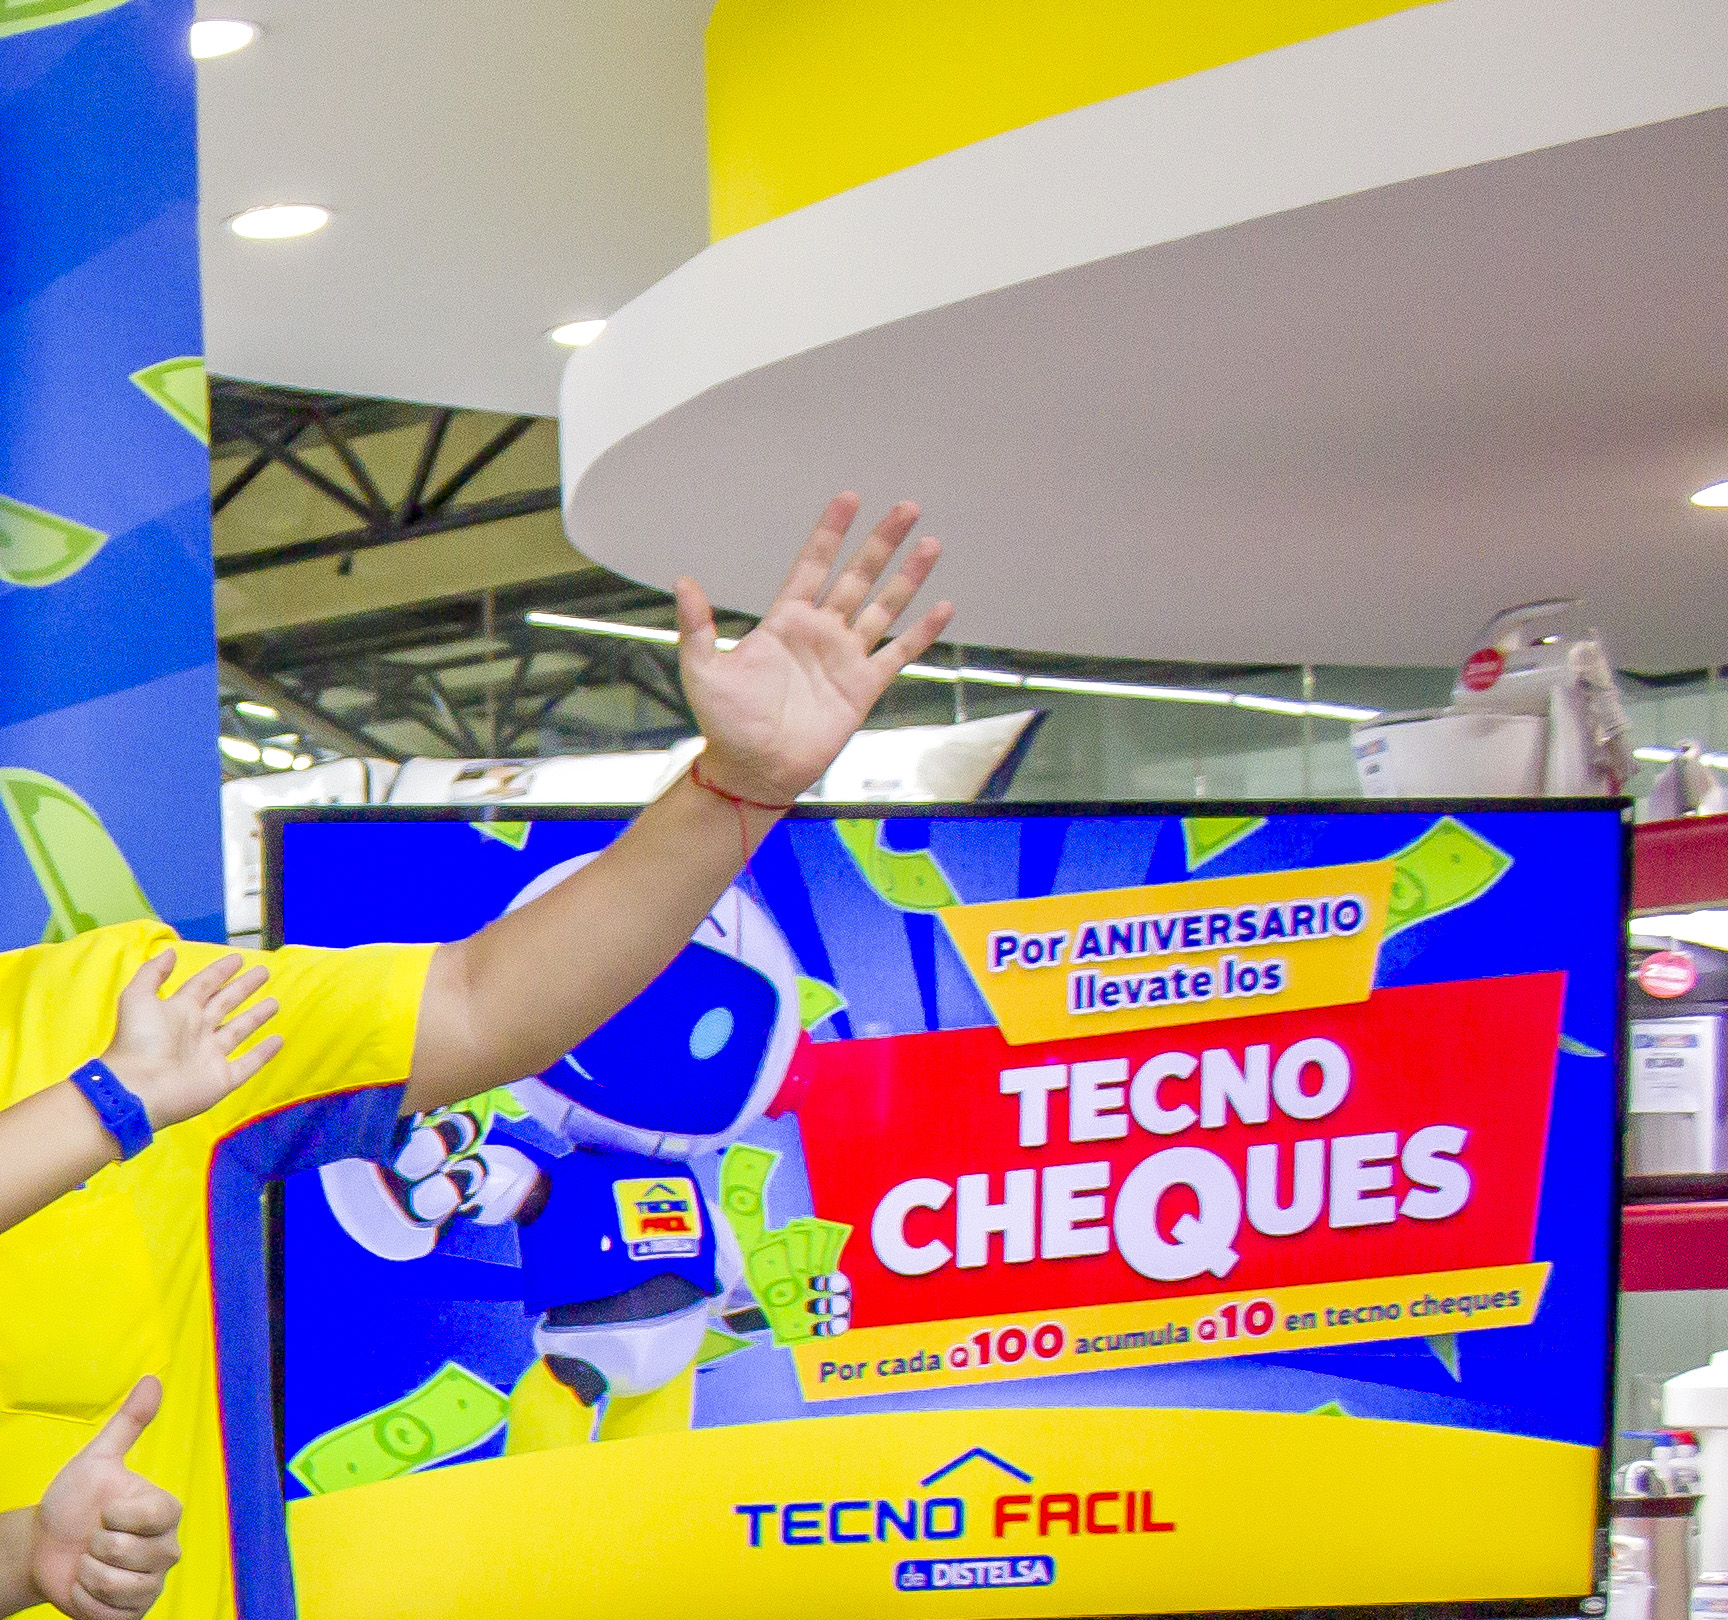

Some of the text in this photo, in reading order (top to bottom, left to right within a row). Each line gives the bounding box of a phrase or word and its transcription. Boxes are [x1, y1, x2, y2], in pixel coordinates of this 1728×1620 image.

[991, 896, 1365, 970] Por ANIVERSARIO
[1070, 957, 1284, 1012] llevate los
[1000, 1037, 1351, 1147] TECNO
[871, 1124, 1471, 1282] CHEQUES
[818, 1288, 1522, 1383] Por cada Q100 acumula Q10 en tecno cheques
[733, 1490, 1176, 1547] TECNO FACIL
[900, 1559, 1051, 1588] de DISTELSA
